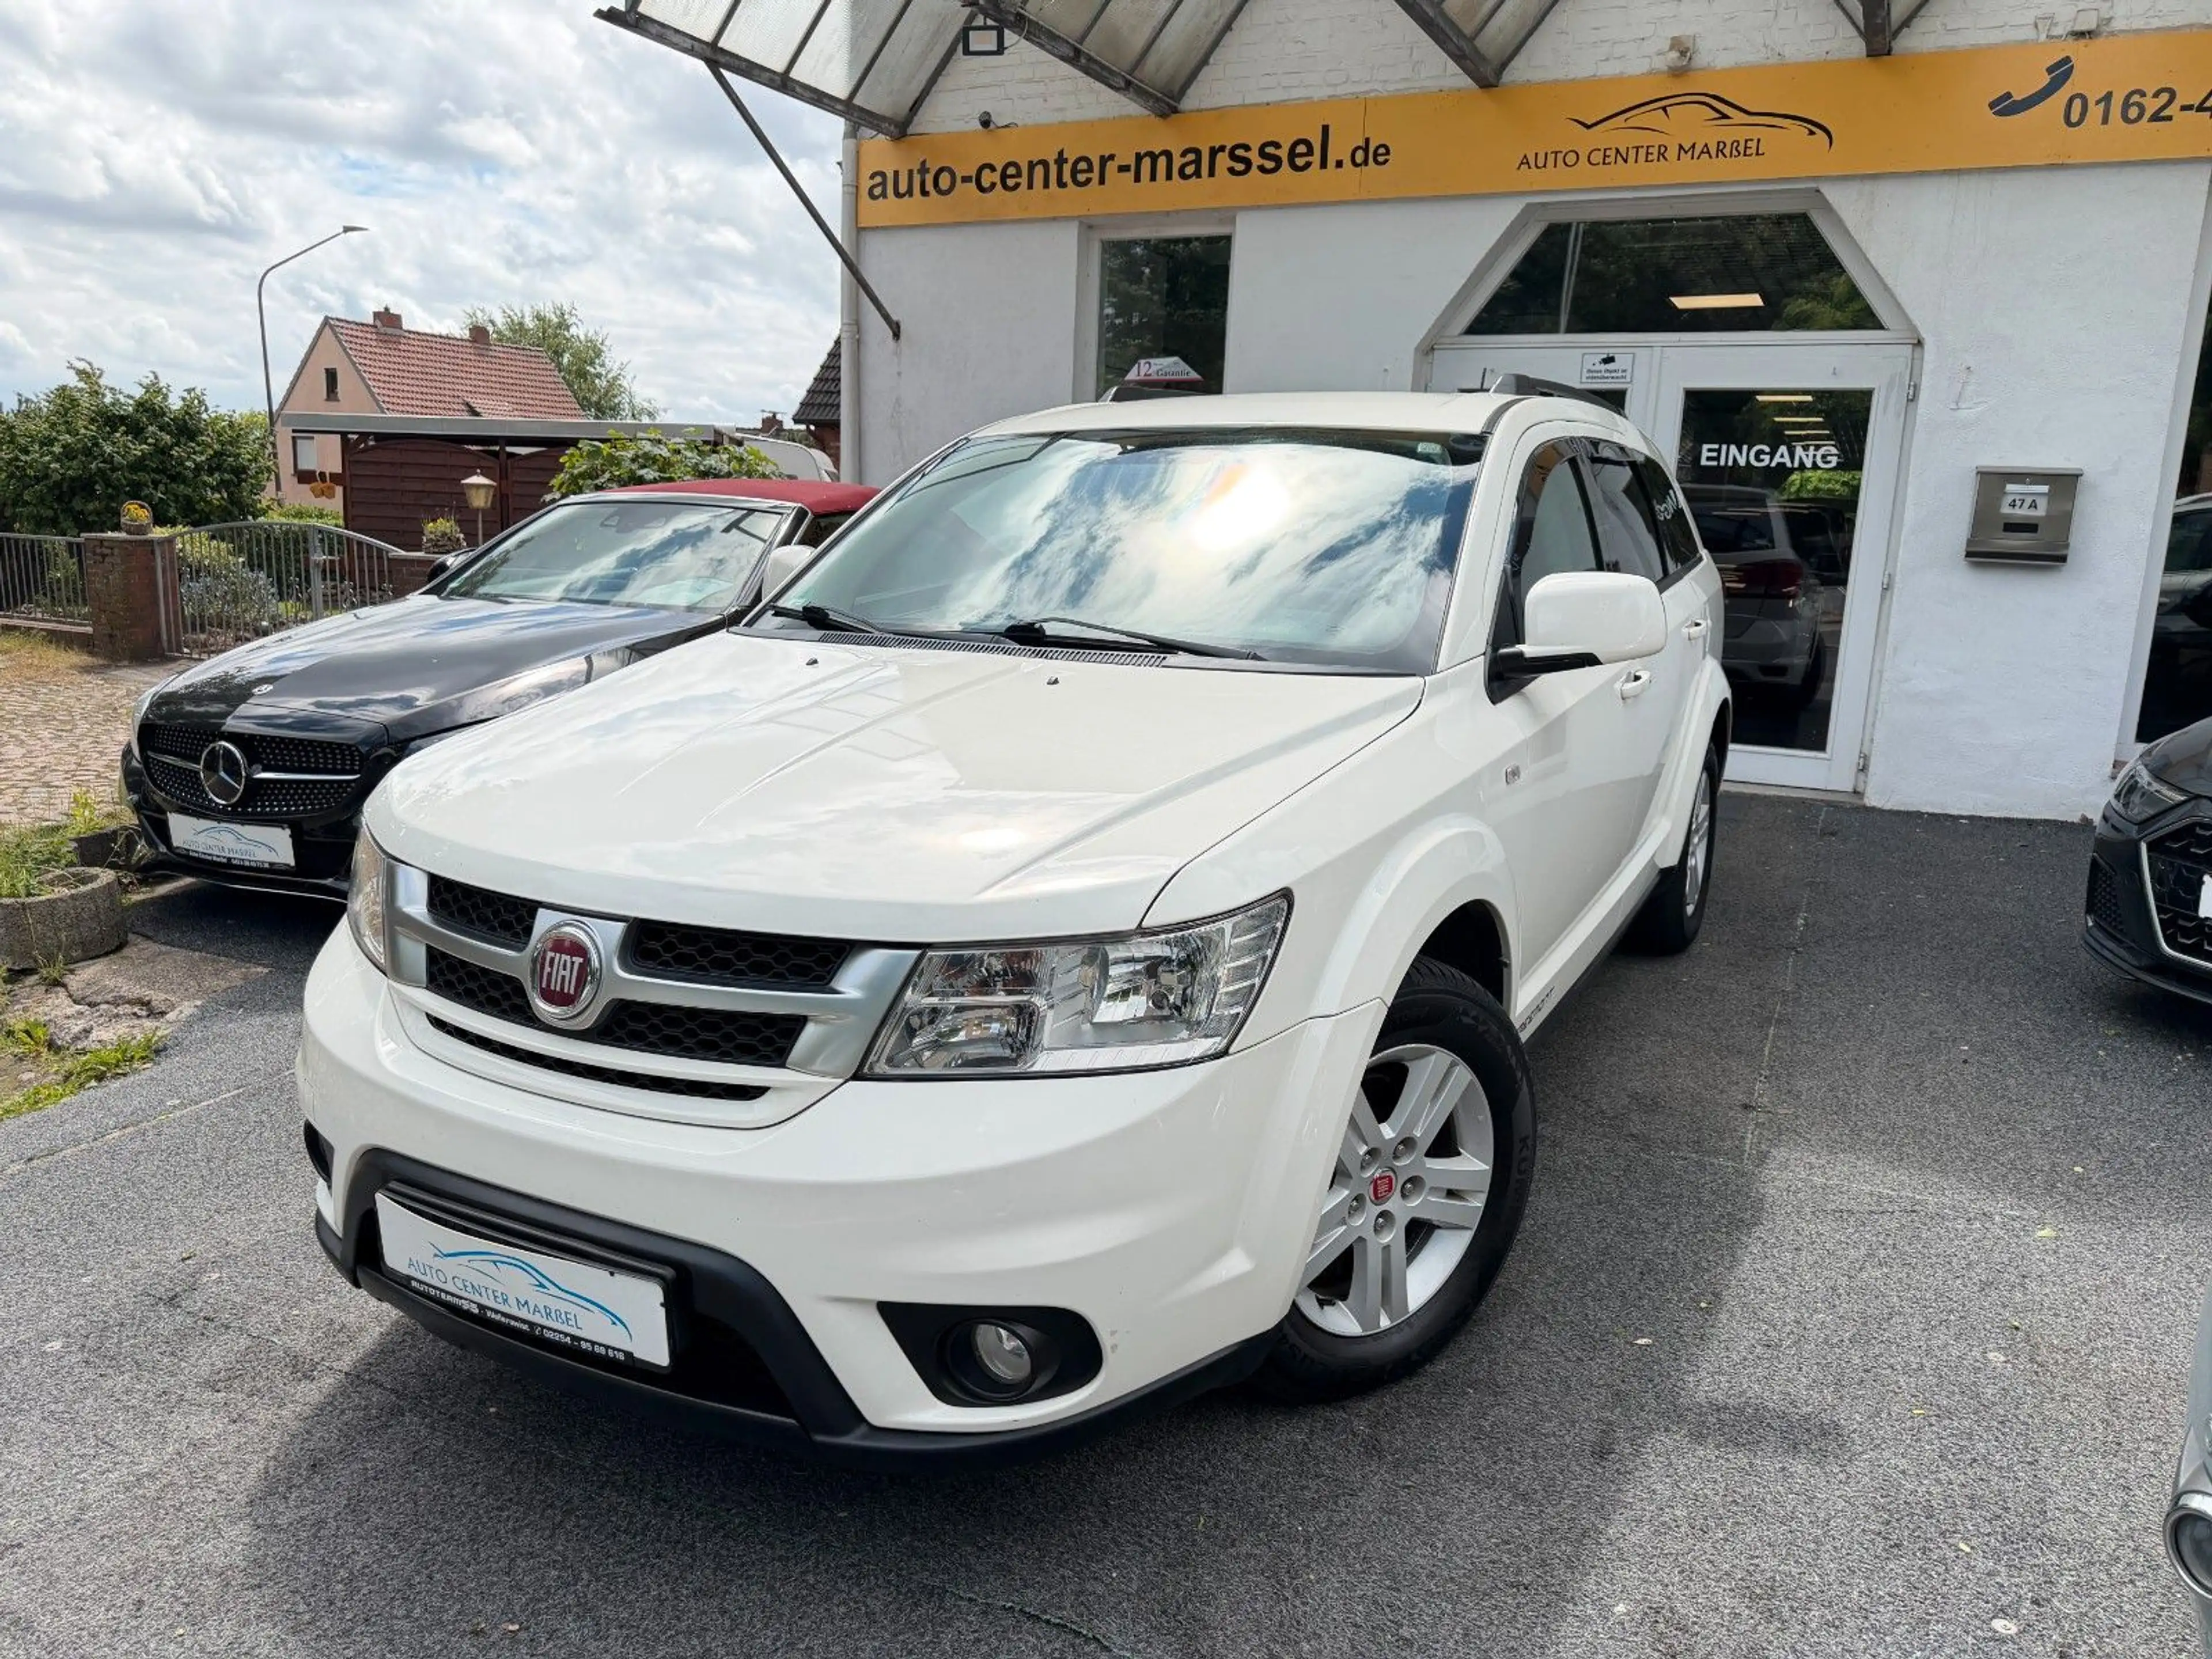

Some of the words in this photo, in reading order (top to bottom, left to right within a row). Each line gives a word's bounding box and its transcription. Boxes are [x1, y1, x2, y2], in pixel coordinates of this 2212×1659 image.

[867, 124, 1391, 201] auto-center-marssel.de
[1516, 149, 1580, 171] AUTO
[1586, 143, 1669, 166] CENTER
[1137, 361, 1153, 377] 12
[1156, 369, 1191, 377] Garantie
[1700, 443, 1840, 469] EINGANG
[2008, 498, 2025, 509] 47
[2028, 499, 2038, 510] A
[542, 951, 584, 995] FIAT
[408, 1257, 448, 1284] AUTO
[452, 1275, 512, 1309] CENTER
